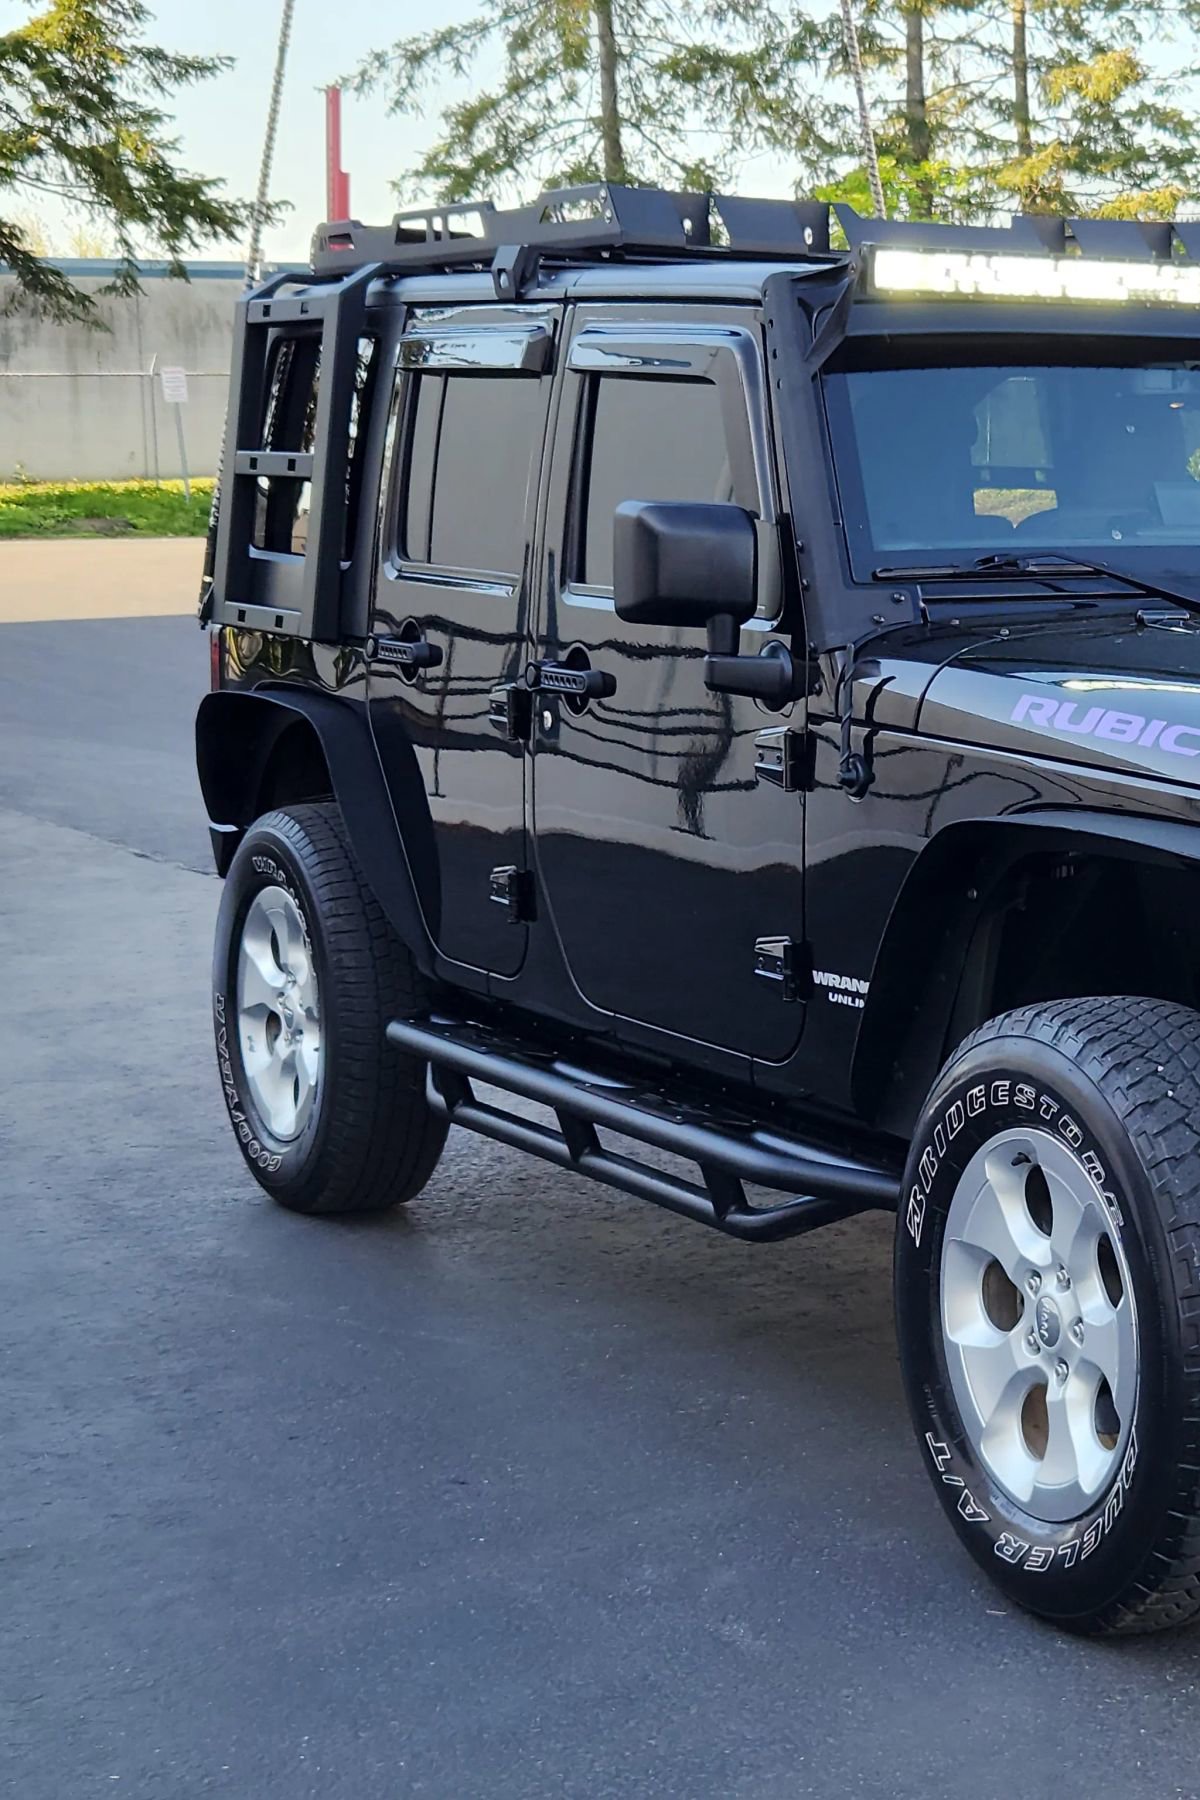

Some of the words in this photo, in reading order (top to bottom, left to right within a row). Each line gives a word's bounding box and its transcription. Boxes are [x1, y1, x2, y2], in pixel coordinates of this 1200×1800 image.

[906, 1080, 1124, 1248] BRIDGESTONE
[924, 1431, 990, 1522] A/T
[993, 1425, 1139, 1572] DUELER
